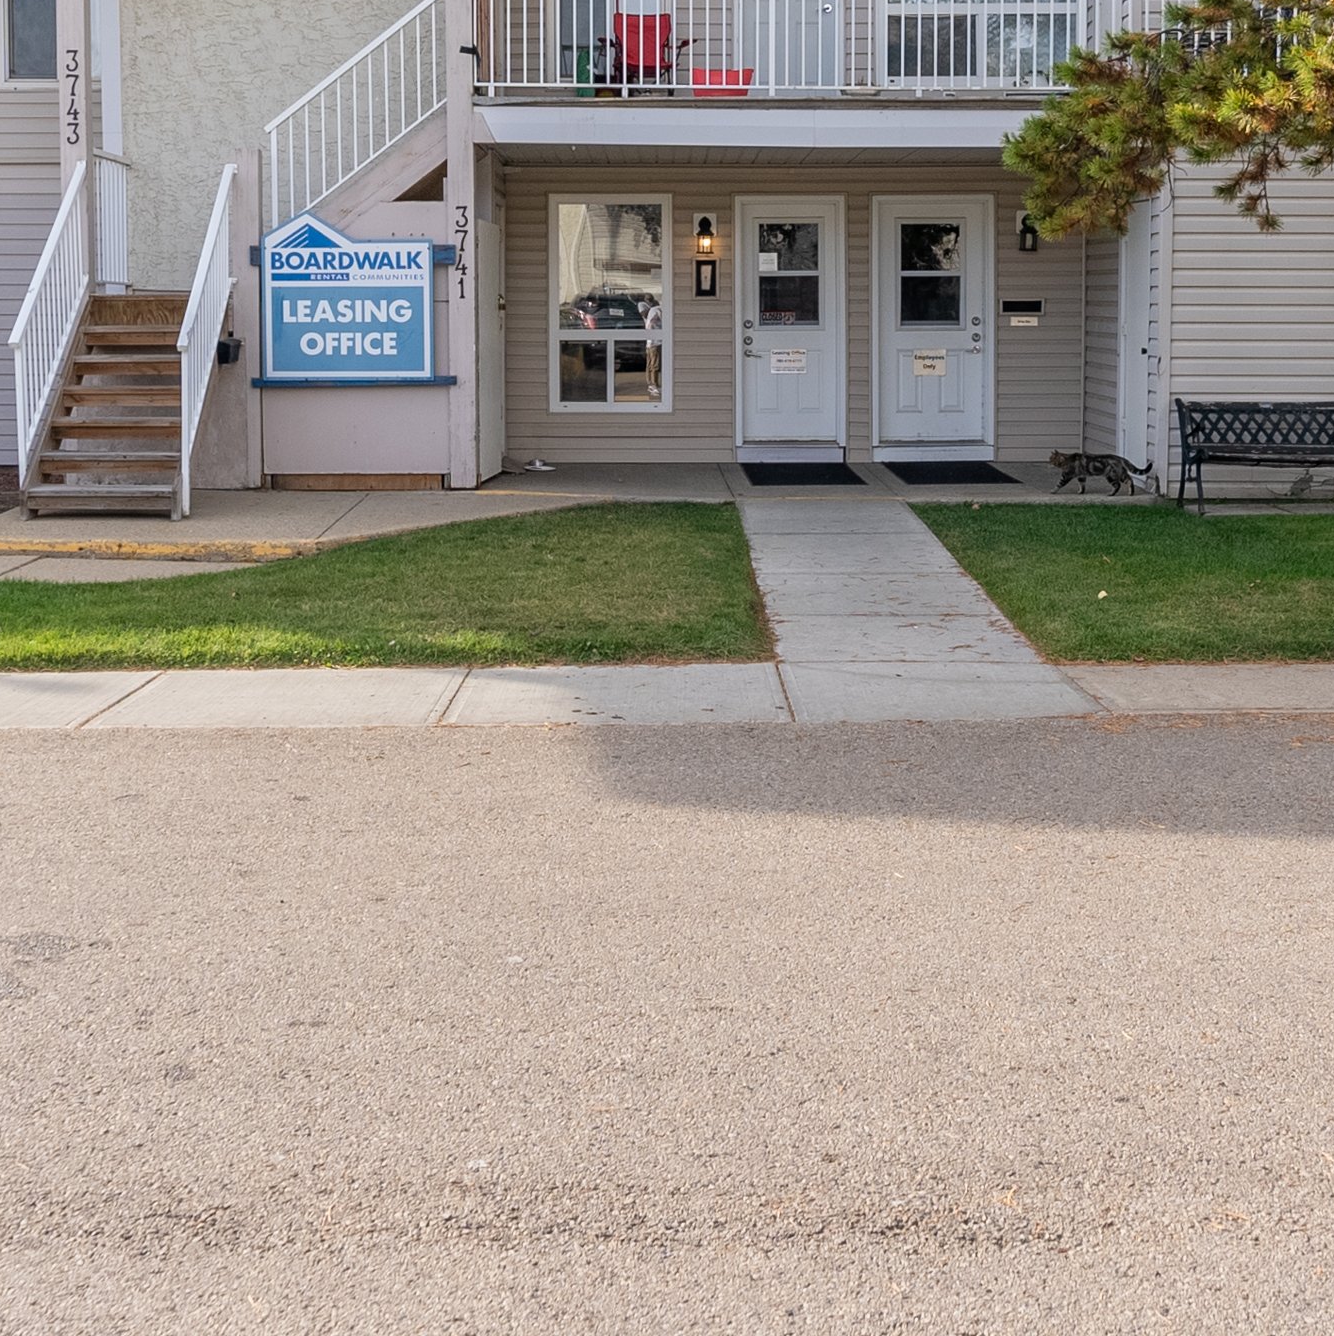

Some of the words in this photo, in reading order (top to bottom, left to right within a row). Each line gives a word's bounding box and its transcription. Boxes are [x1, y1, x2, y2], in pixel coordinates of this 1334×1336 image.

[65, 49, 80, 145] 3743
[270, 251, 423, 270] BOARDWALK
[454, 205, 469, 299] 3741
[310, 273, 348, 281] RENTAL
[352, 273, 424, 281] COMMUNITIES
[282, 299, 413, 324] LEASING
[299, 331, 398, 356] OFFICE
